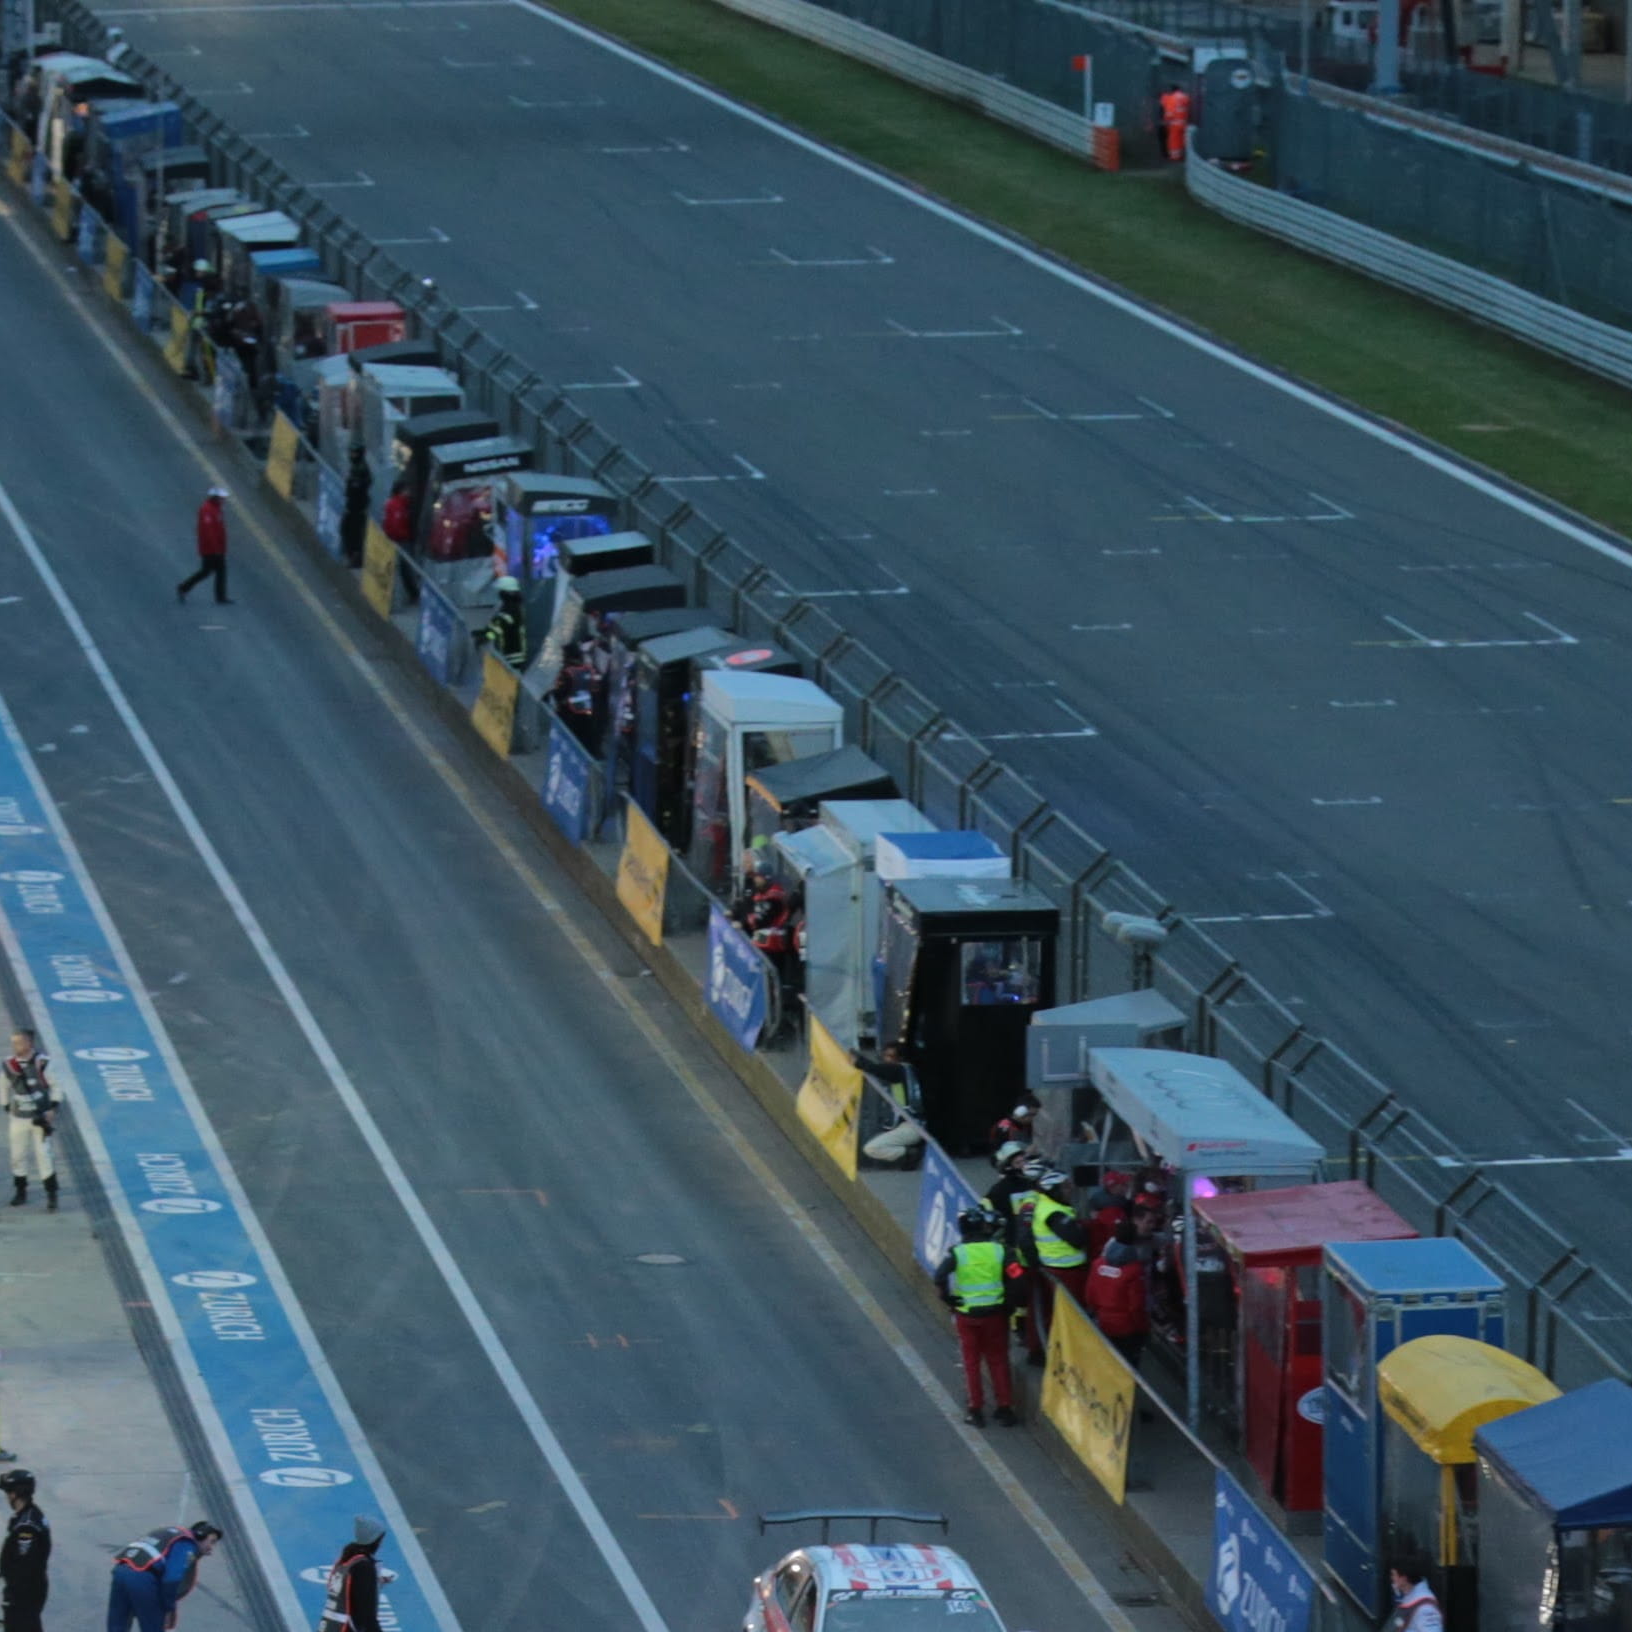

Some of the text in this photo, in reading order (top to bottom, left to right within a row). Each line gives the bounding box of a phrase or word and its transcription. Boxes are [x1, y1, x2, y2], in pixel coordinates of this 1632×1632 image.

[97, 1063, 155, 1101] ZURICH
[135, 1152, 197, 1195] ZURICH
[198, 1292, 265, 1341] ZURICH
[250, 1408, 321, 1461] ZURICH
